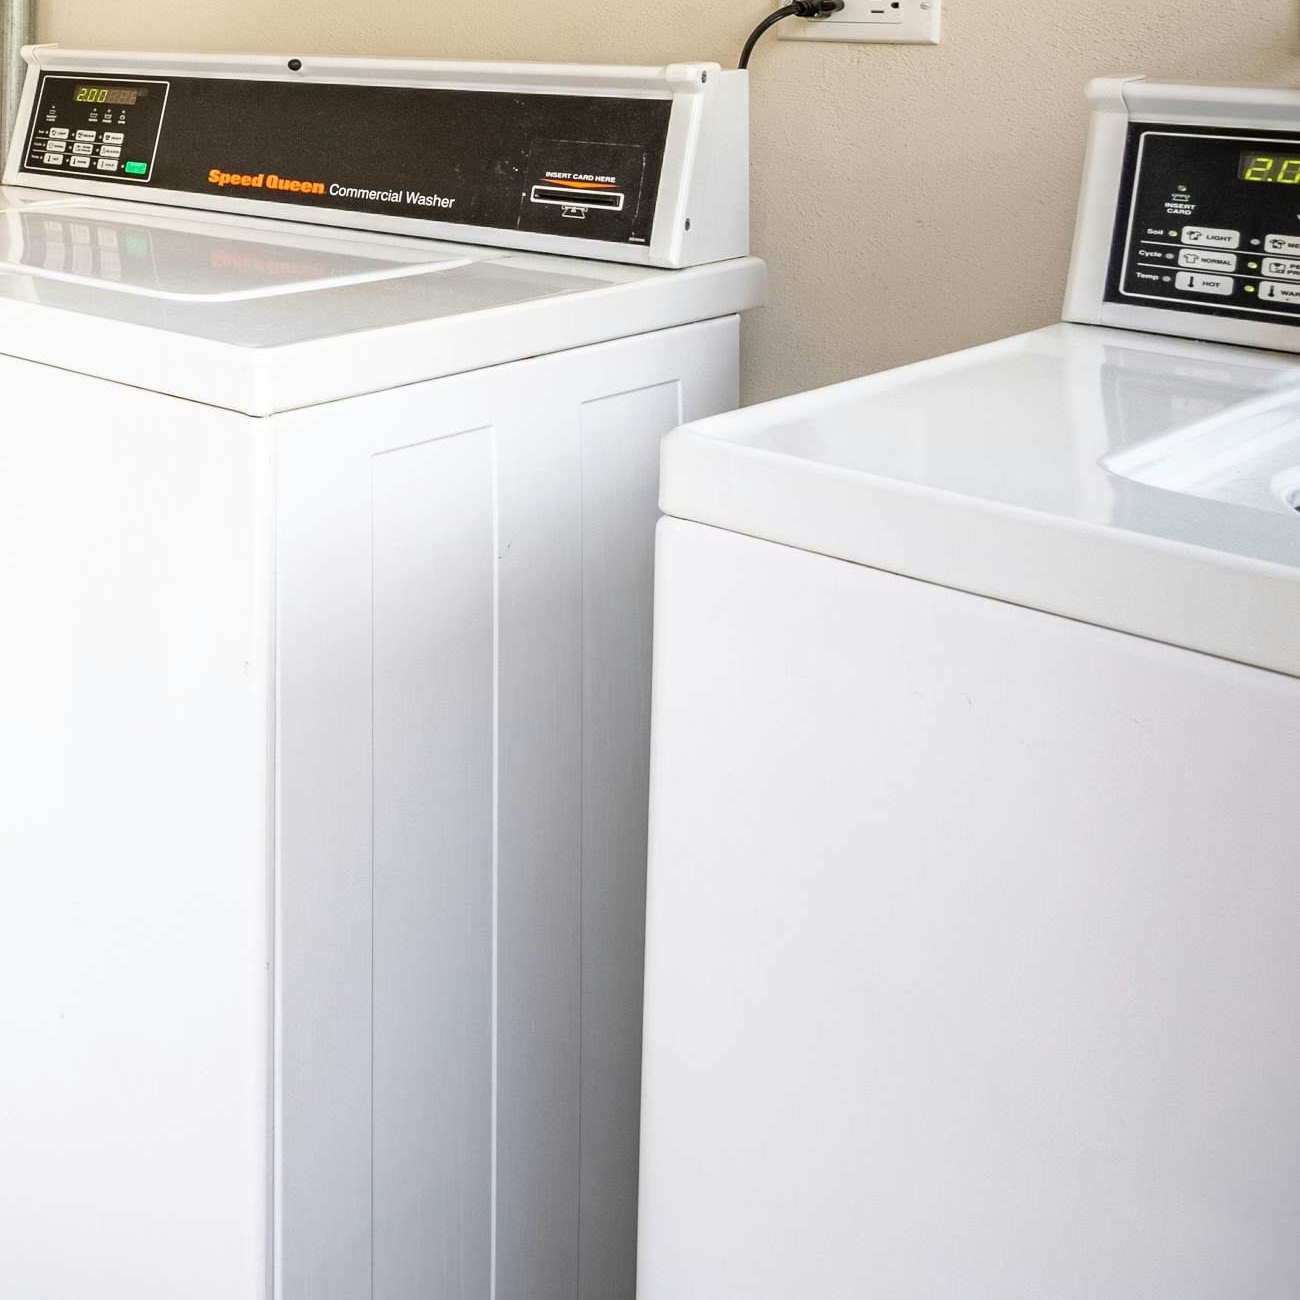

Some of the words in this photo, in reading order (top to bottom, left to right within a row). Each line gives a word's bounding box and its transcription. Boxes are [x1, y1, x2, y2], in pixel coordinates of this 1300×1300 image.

[77, 88, 109, 103] 2.00
[545, 171, 572, 180] INSERT
[572, 173, 594, 182] CARD
[594, 175, 617, 183] HERE
[207, 169, 264, 188] Speed
[266, 174, 325, 194] Queen
[329, 183, 403, 203] Commercial
[405, 191, 456, 209] Washer
[1165, 202, 1196, 210] INSERT
[1166, 208, 1192, 216] CARD
[1147, 228, 1164, 236] Soil
[1206, 234, 1233, 242] LIGHT
[1138, 250, 1162, 258] Cycle
[1201, 257, 1232, 266] NORMAL
[1136, 272, 1159, 281] Temp
